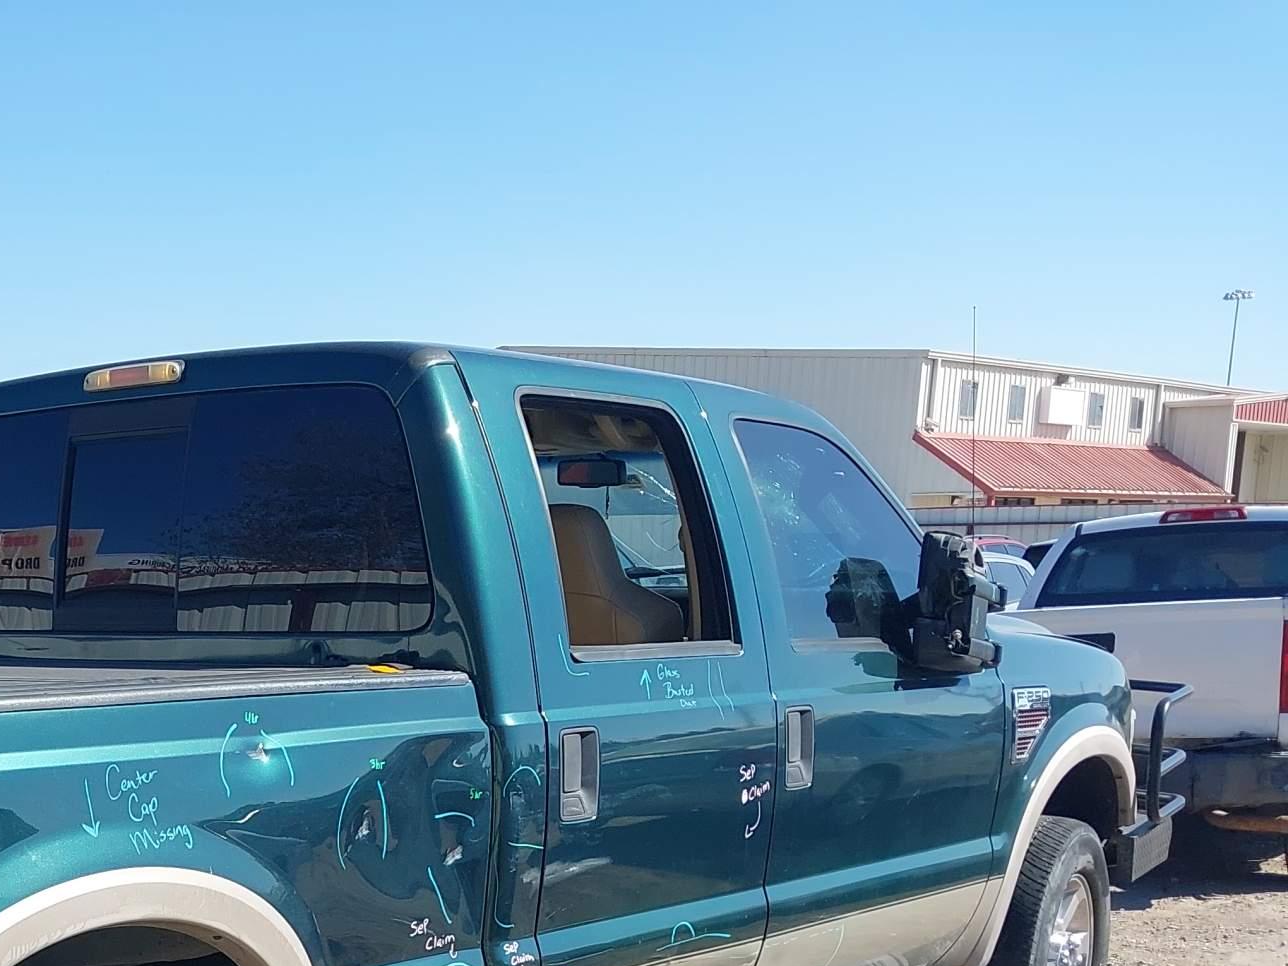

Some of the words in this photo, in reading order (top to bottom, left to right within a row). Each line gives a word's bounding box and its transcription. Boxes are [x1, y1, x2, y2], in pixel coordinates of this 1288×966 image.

[105, 763, 158, 801] Center
[128, 792, 158, 827] Cap
[129, 824, 193, 855] Missing
[425, 934, 456, 951] Claim
